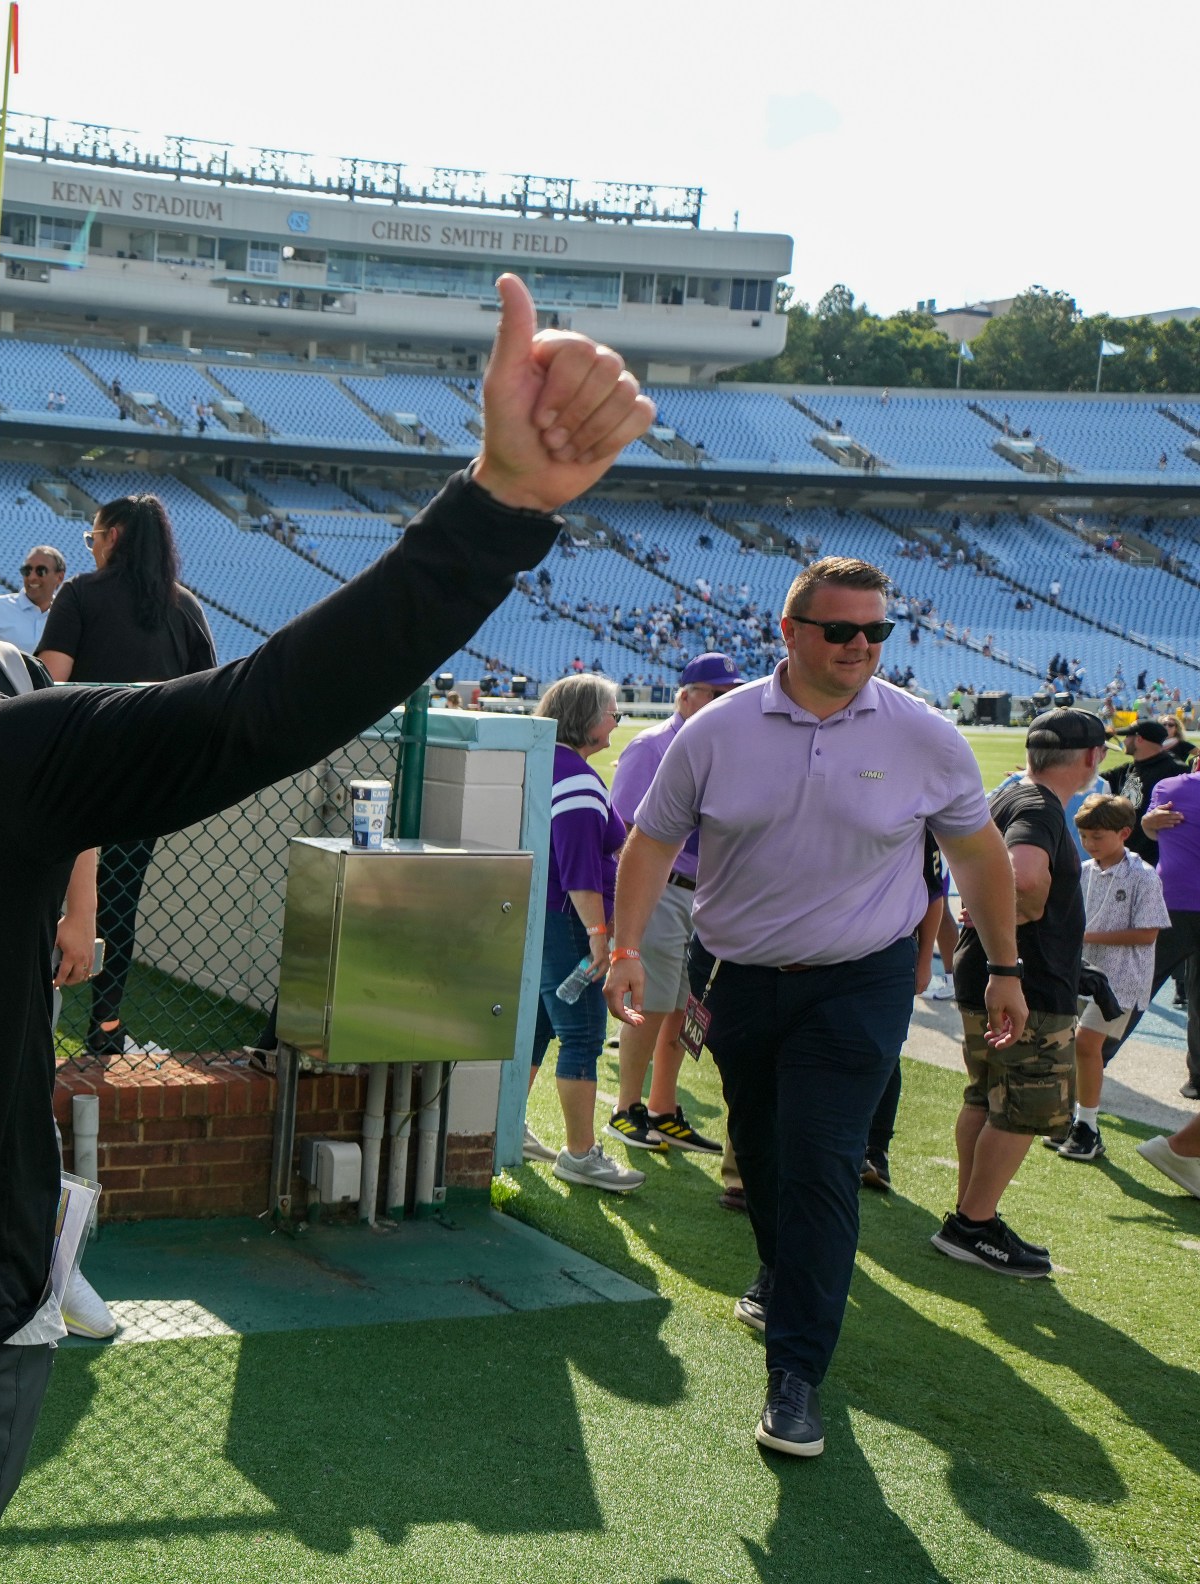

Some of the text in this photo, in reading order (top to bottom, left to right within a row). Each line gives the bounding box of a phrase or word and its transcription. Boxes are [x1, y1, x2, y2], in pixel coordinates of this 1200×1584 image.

[52, 181, 223, 221] KENAN STADIUM
[372, 221, 569, 254] CHRIS SMITH FIELD
[974, 1240, 1009, 1263] HOKA
